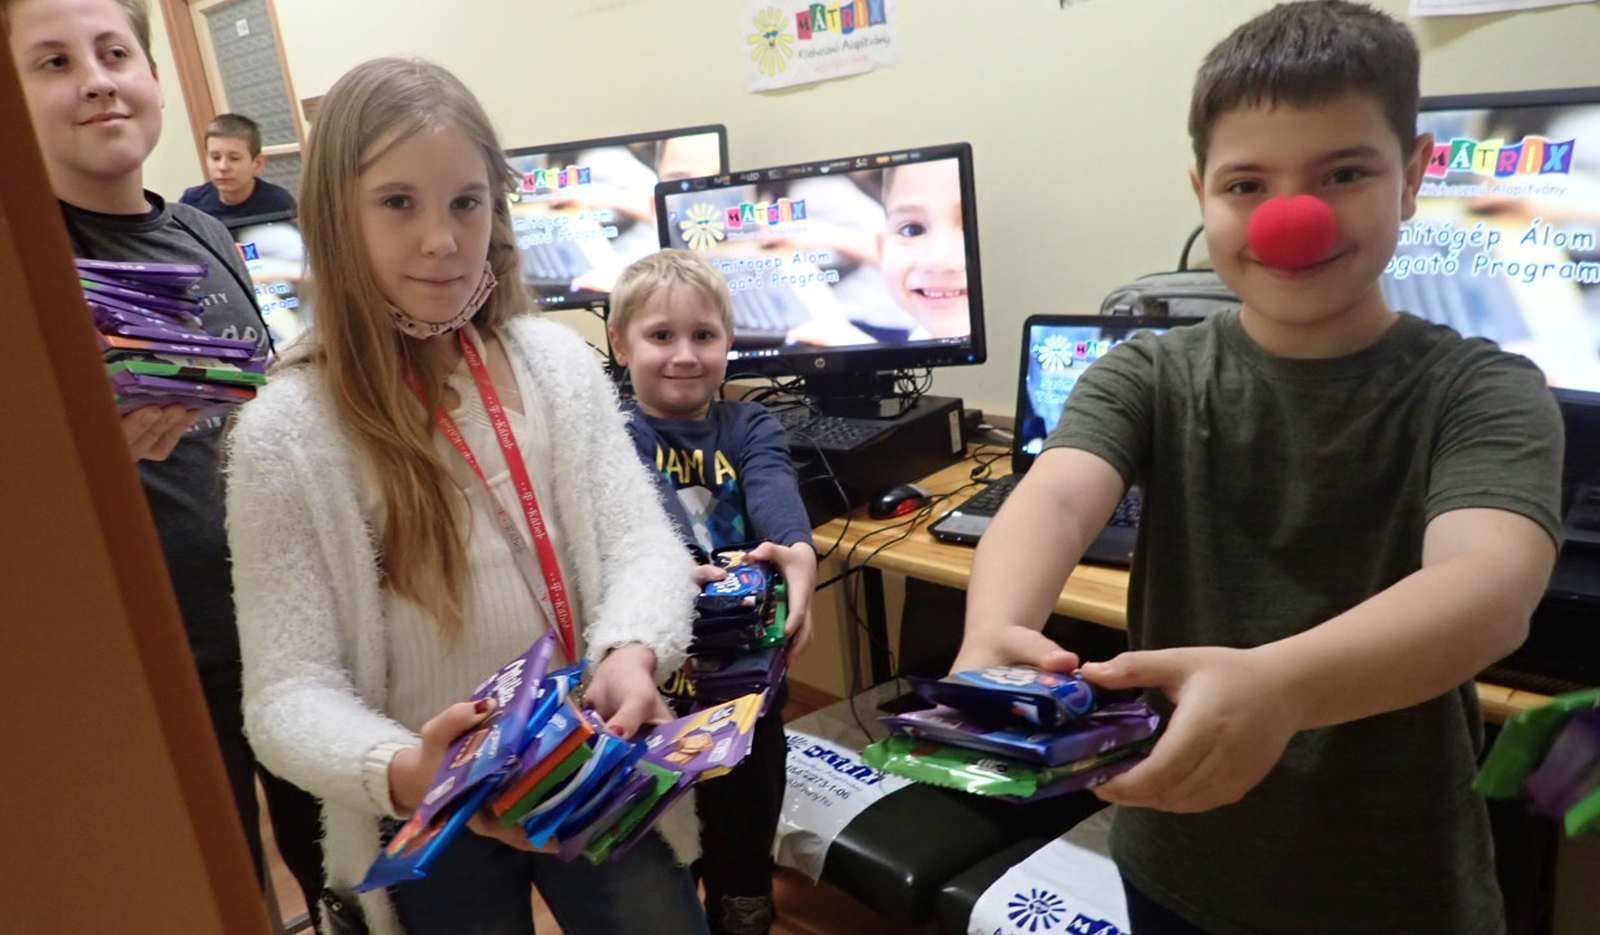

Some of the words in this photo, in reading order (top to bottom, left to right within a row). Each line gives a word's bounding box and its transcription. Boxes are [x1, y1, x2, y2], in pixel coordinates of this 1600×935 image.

[1425, 135, 1576, 178] MÁTRIX
[1399, 222, 1502, 248] mítógép
[1519, 217, 1593, 248] Álom
[1386, 250, 1459, 276] ogató
[1473, 254, 1600, 283] Program
[667, 448, 705, 484] AM
[714, 450, 737, 485] A
